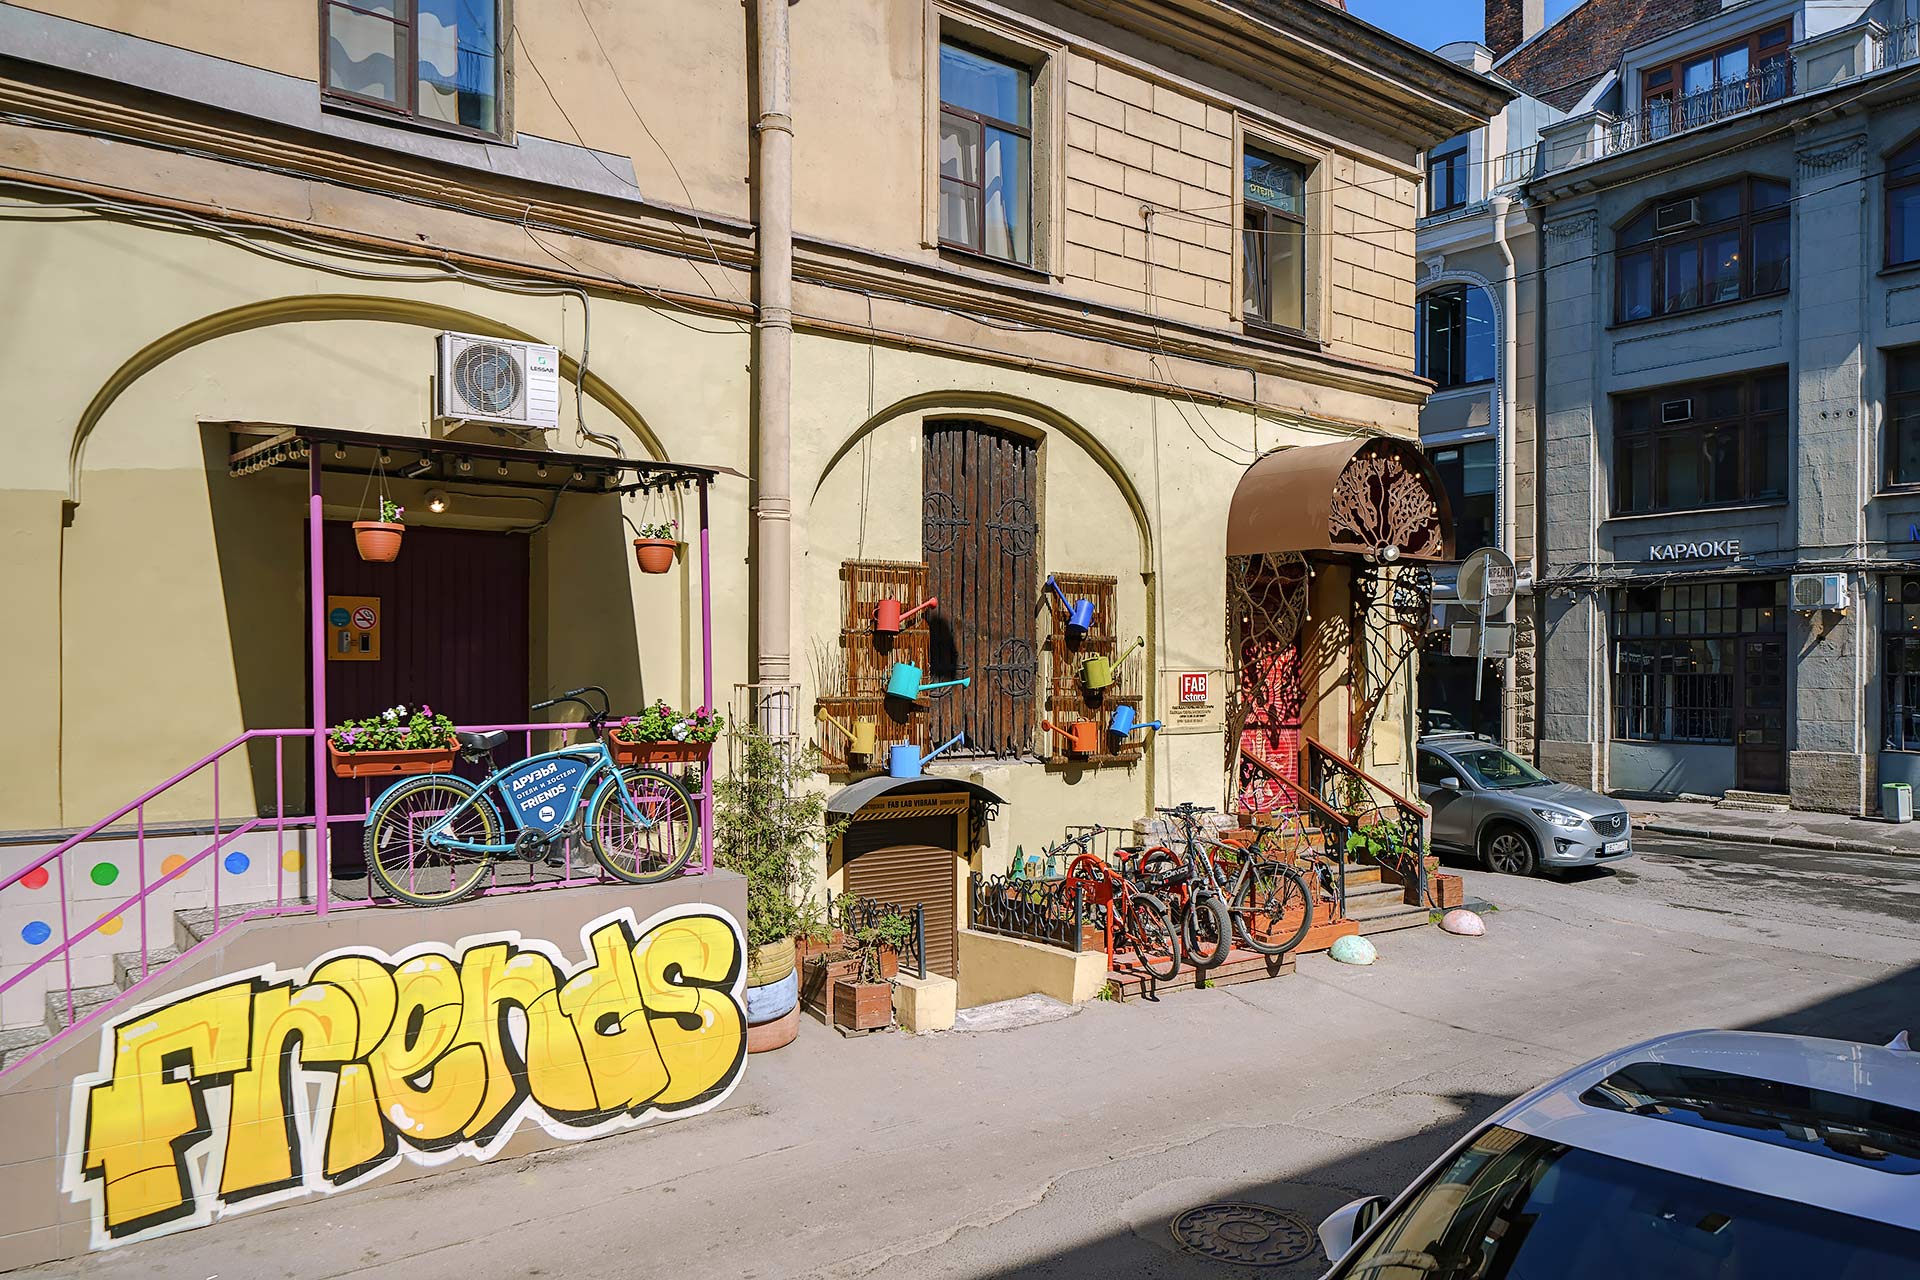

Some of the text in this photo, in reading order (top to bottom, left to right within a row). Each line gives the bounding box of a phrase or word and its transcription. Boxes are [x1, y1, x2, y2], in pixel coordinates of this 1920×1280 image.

[530, 365, 555, 374] LESSAR
[1649, 540, 1740, 560] КАРАОКЕ
[1488, 567, 1514, 578] КРЕДИТ
[1184, 676, 1206, 692] FAB
[1184, 692, 1206, 702] store
[512, 762, 558, 791] ДРУЗЬЯ
[520, 783, 567, 812] FRIENDS
